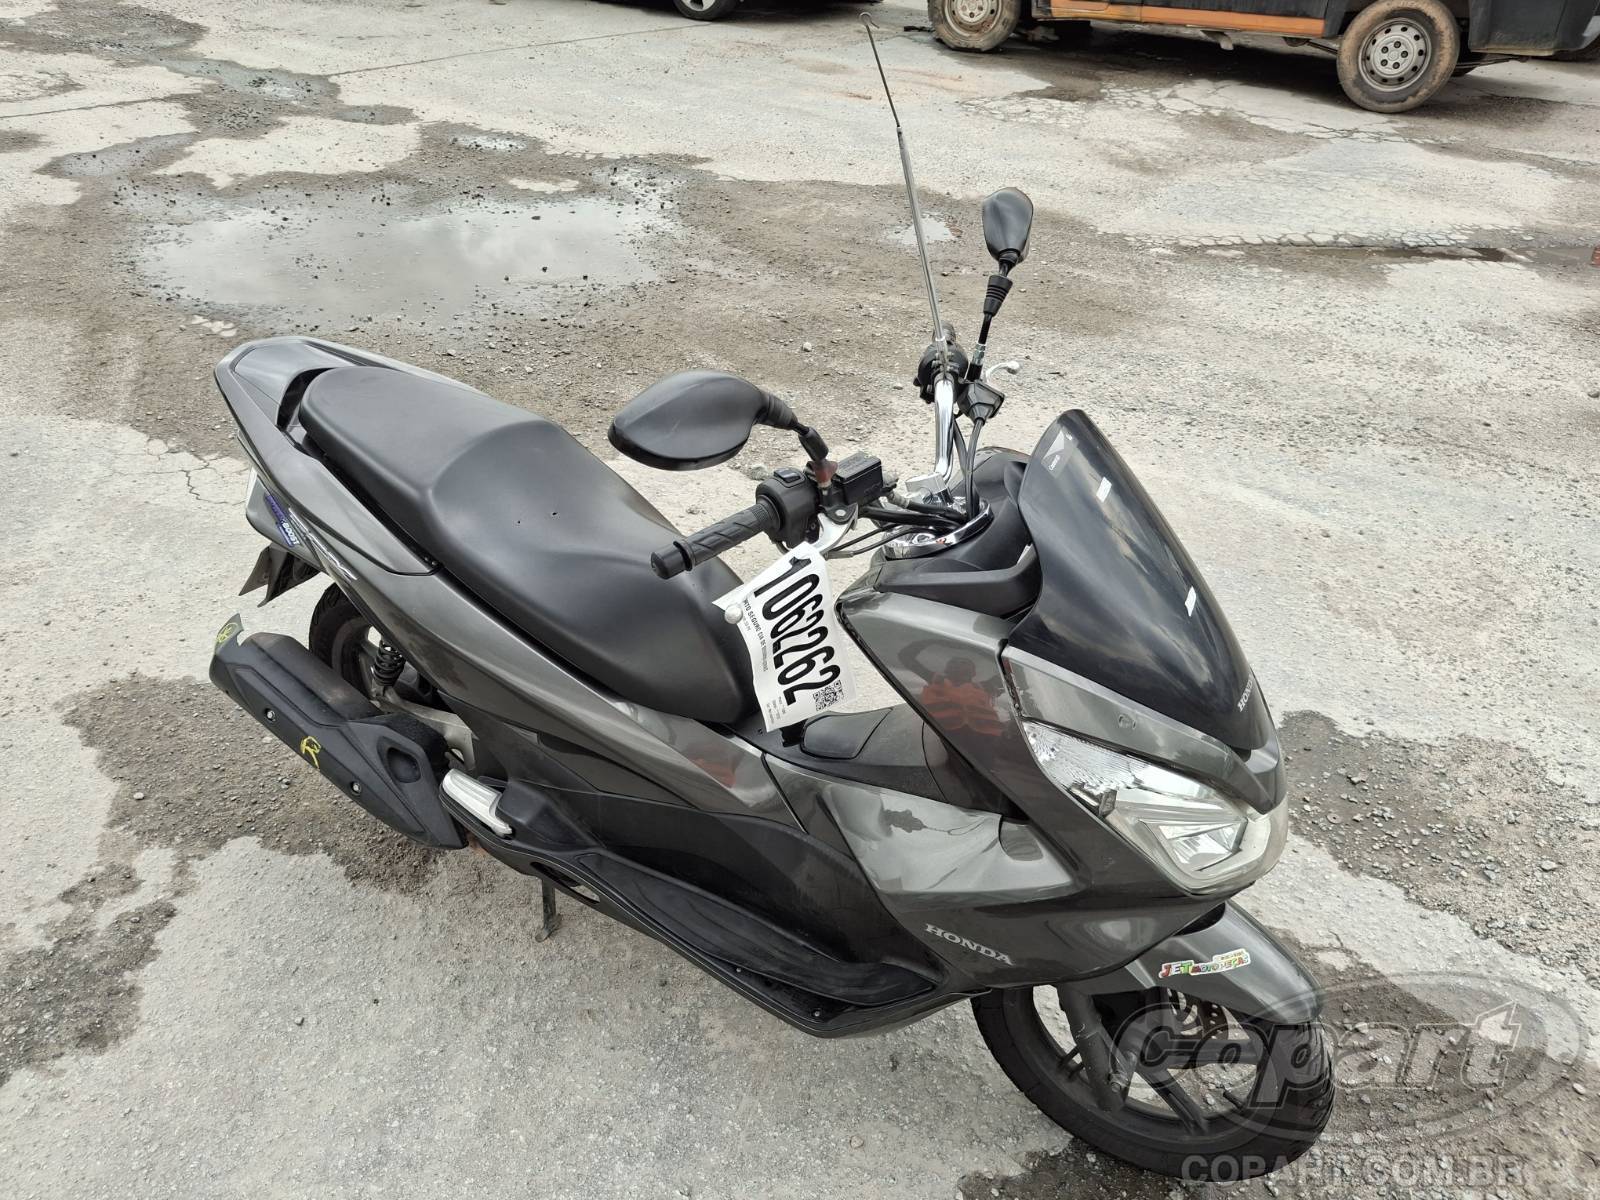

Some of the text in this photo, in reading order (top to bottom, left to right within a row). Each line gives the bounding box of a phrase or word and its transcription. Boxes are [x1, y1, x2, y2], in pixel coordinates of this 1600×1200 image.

[282, 522, 300, 545] BOOST
[753, 556, 841, 706] 1062262
[925, 923, 1015, 966] HONDA
